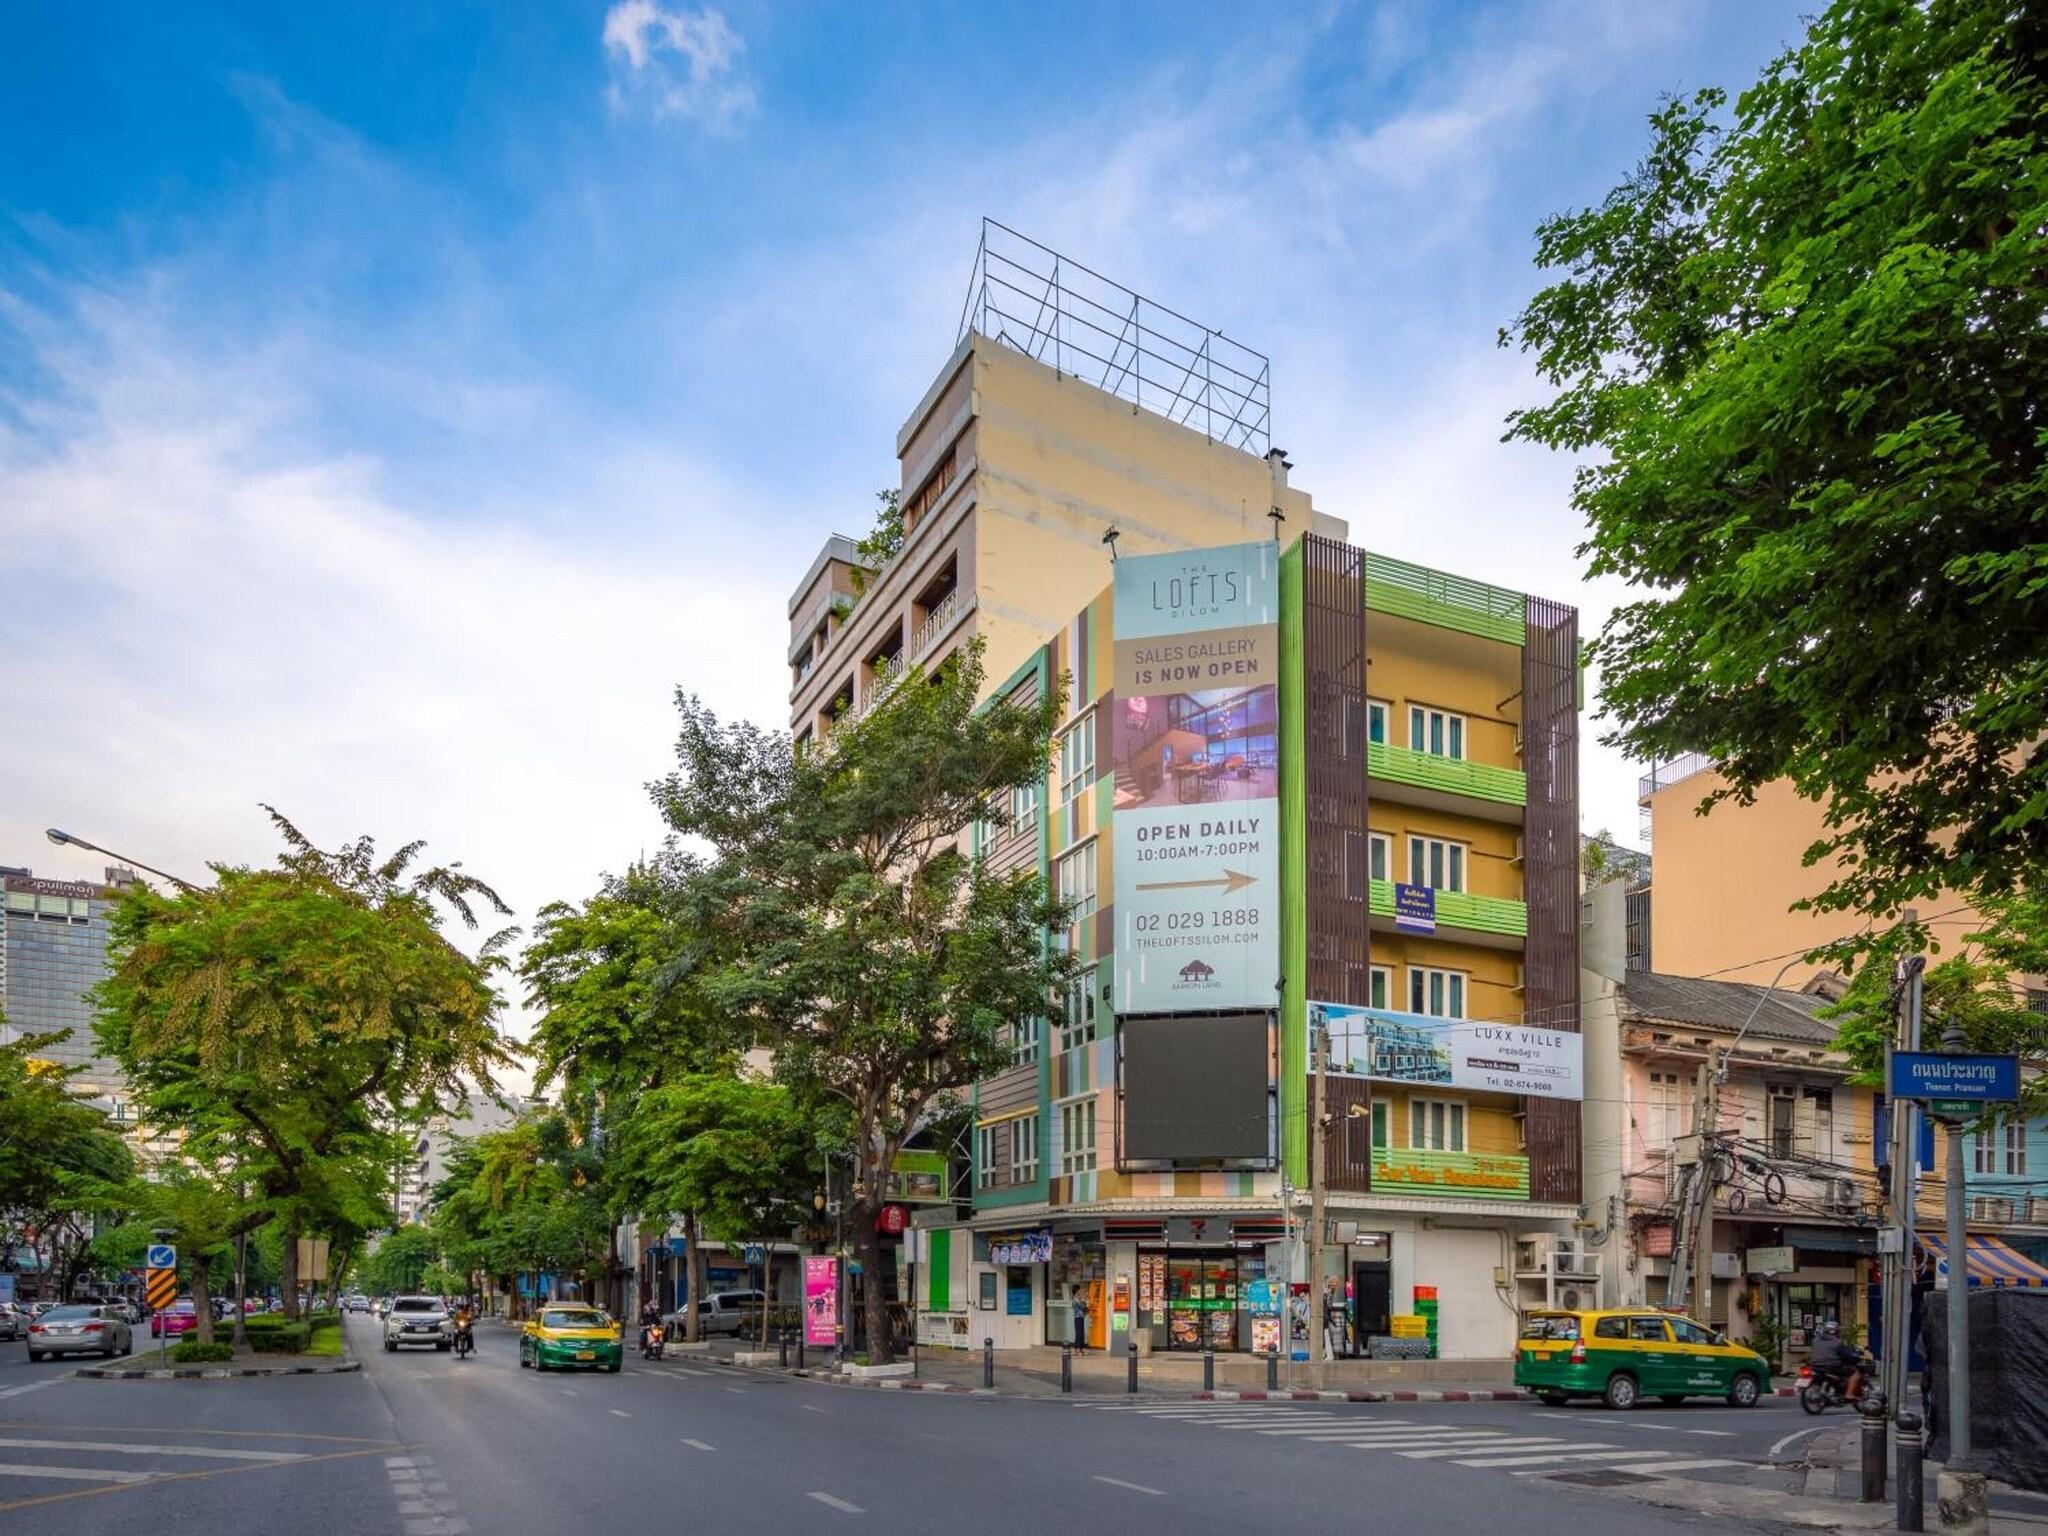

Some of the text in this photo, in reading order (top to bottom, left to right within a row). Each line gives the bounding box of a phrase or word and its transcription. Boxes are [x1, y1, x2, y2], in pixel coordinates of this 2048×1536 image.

[1182, 565, 1207, 574] THE
[1153, 571, 1237, 610] LOFTS
[1171, 607, 1219, 618] SILOM
[1135, 638, 1256, 665] SALES GALLERY
[1135, 659, 1259, 685] IS NOW OPEN
[1137, 818, 1260, 842] OPEN DAILY
[1137, 841, 1260, 862] 10:00AM-7:00PM
[37, 881, 95, 896] pullman
[1136, 908, 1260, 931] 02 029 1888
[1136, 932, 1259, 949] THELOFTSSILOM.COM
[1475, 1028, 1562, 1048] LUXX VILLE
